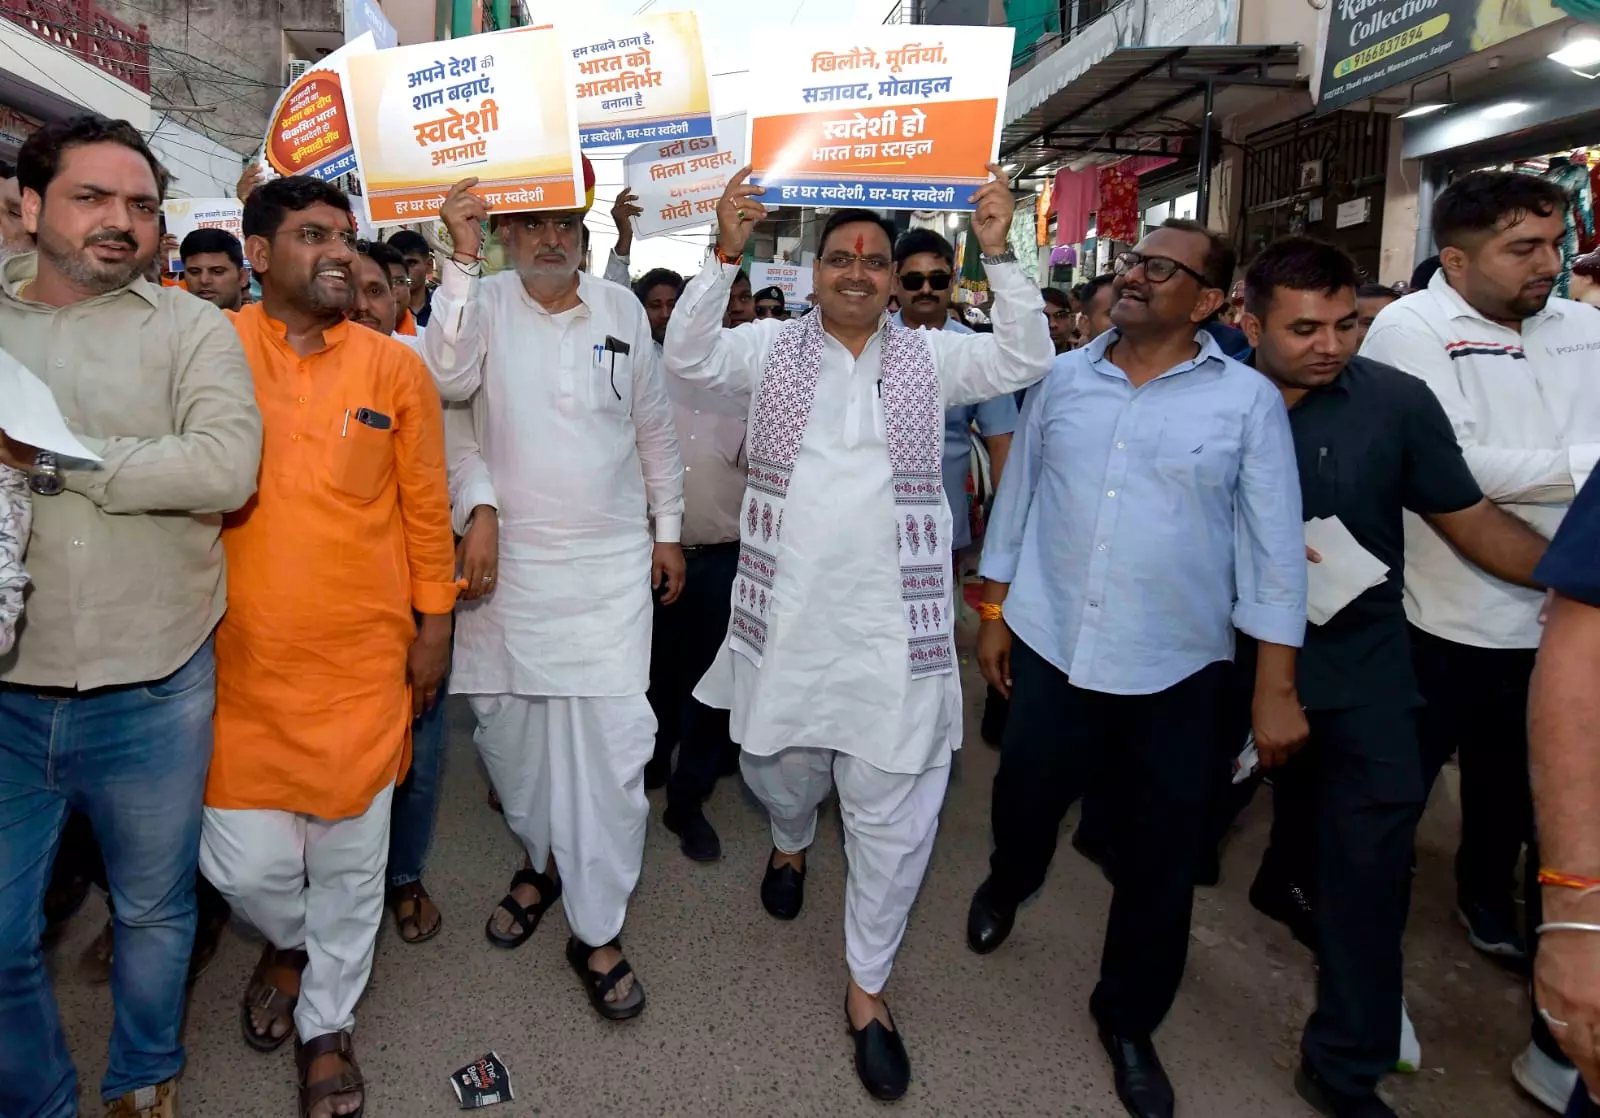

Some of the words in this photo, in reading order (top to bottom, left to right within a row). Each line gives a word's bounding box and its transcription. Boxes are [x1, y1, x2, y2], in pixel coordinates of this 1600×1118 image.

[572, 46, 588, 58] हम
[590, 39, 616, 53] सबने
[618, 36, 641, 48] ठाना
[578, 56, 622, 74] भारत
[625, 46, 650, 67] को
[811, 46, 880, 73] खिलौने,
[885, 41, 948, 73] मूर्तियां,
[1353, 27, 1423, 68] 9166837894
[408, 60, 445, 88] अपने
[448, 56, 476, 76] देश
[480, 54, 494, 68] की
[575, 67, 662, 98] आत्मनिर्भर
[412, 88, 444, 110] शान
[446, 73, 494, 103] बढ़ाएं,
[601, 96, 632, 110] बनाना
[634, 92, 642, 106] है
[802, 82, 873, 104] सजावट,
[878, 75, 952, 98] मोबाइल
[304, 104, 316, 116] का
[316, 94, 332, 110] दीप
[281, 118, 316, 142] विकसित
[316, 106, 337, 123] भारत
[300, 126, 322, 143] स्वदेशी
[413, 98, 500, 147] स्वदेशी
[590, 128, 624, 142] स्वदेशी,
[626, 127, 656, 138] घर-घर
[658, 120, 689, 136] स्वदेशी
[822, 109, 898, 140] स्वदेशी
[901, 107, 927, 138] हो
[290, 136, 324, 164] बुनियादी
[431, 136, 487, 166] अपनाएं
[812, 144, 852, 162] भारत
[854, 143, 878, 158] का
[880, 140, 934, 158] स्टाइल
[650, 162, 686, 182] मिला
[690, 150, 736, 172] उपहार,
[394, 201, 408, 214] हर
[410, 199, 424, 210] घर
[504, 186, 545, 204] स्वदेशी
[782, 185, 798, 198] हर
[800, 186, 818, 199] घर
[820, 184, 866, 201] स्वदेशी,
[868, 188, 910, 201] घर-घर
[912, 186, 956, 203] स्वदेशी
[660, 200, 693, 220] मोदी
[466, 1065, 482, 1088] Beans
[485, 1061, 496, 1078] The
